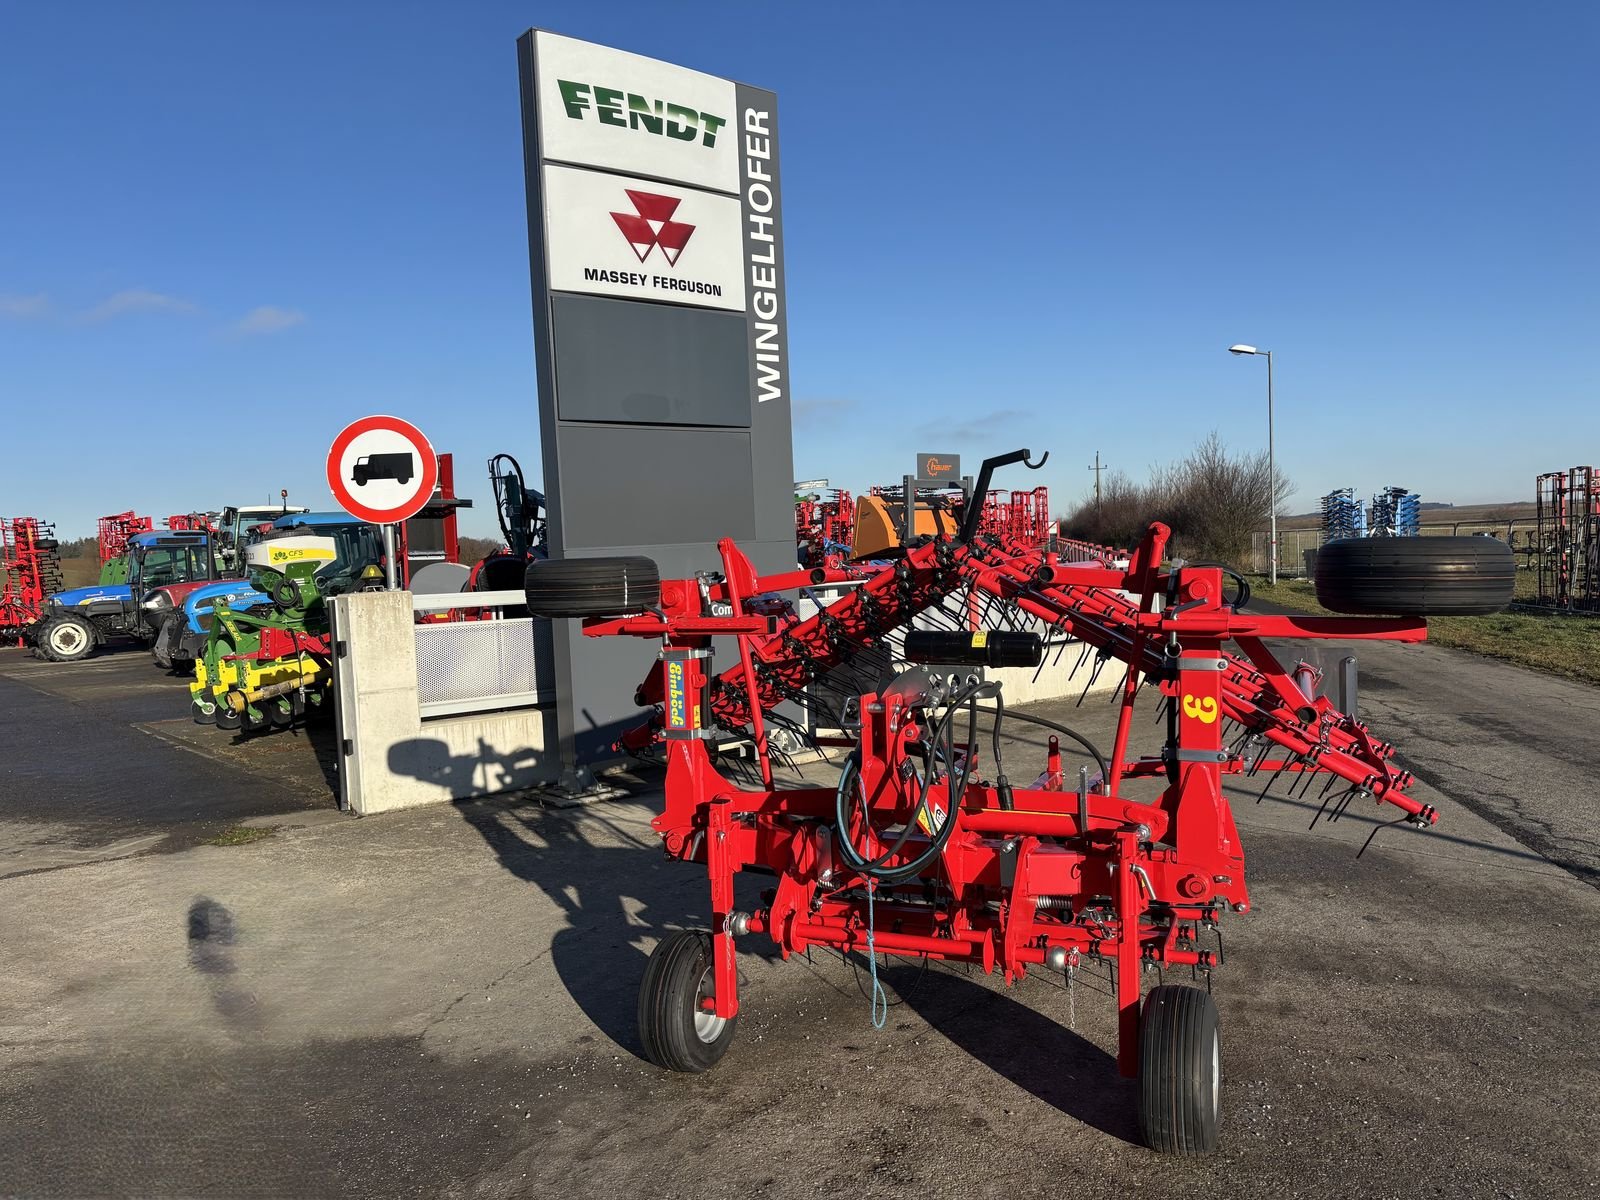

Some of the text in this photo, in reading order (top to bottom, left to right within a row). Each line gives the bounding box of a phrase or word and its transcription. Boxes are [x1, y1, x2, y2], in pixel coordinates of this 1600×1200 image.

[557, 79, 727, 149] FENDT
[584, 267, 722, 297] MASSEY FERGUSON
[744, 107, 782, 403] WINGELHOFER
[669, 662, 684, 727] Einböck
